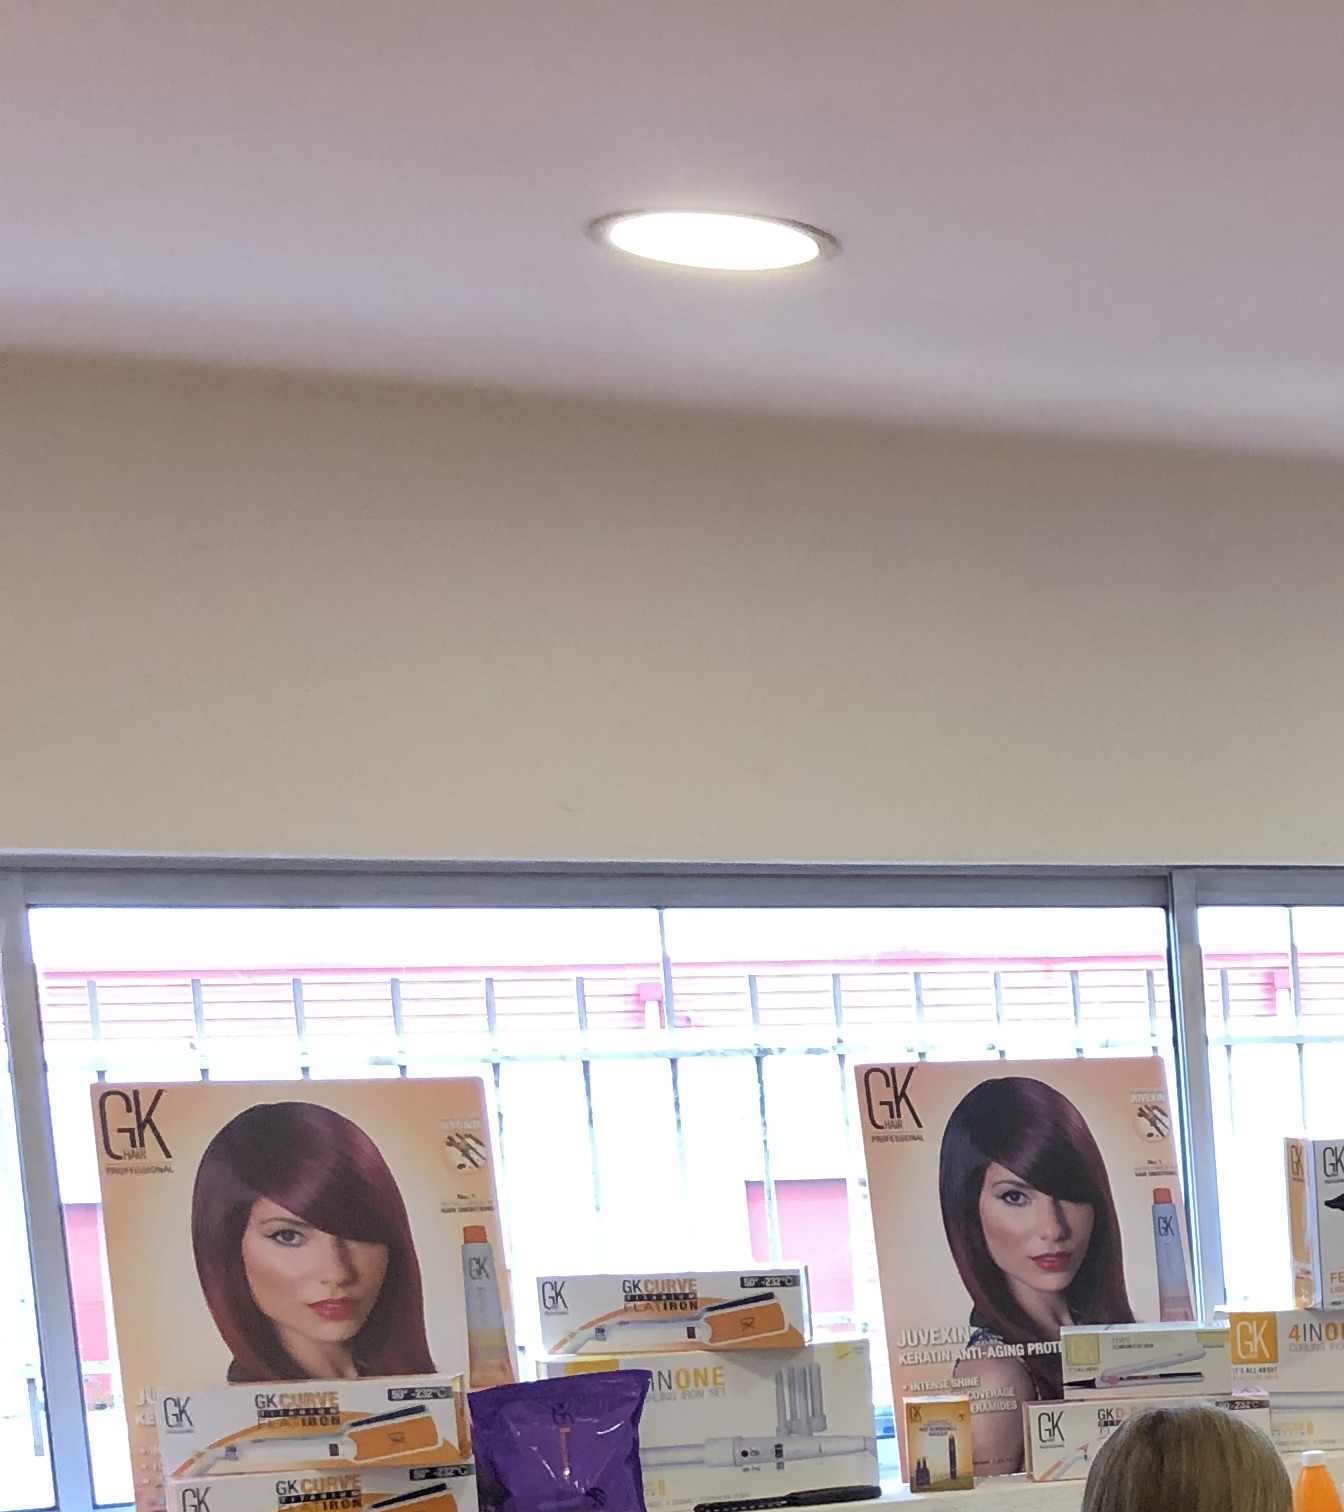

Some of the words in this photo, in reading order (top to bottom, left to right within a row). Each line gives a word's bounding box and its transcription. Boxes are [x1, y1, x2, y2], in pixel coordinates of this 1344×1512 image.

[864, 1066, 923, 1129] GK
[99, 1089, 172, 1160] GK
[872, 1134, 924, 1143] PROFESSIONAL
[1157, 1216, 1175, 1236] GK
[469, 1257, 490, 1279] GK
[542, 1281, 568, 1310] GK
[898, 1327, 970, 1348] JUVEXIN
[1237, 1320, 1270, 1359] GK
[899, 1350, 951, 1366] KERATIN
[954, 1345, 1025, 1361] ANTI-AGING
[911, 1379, 950, 1391] INTENSE
[952, 1377, 980, 1388] SHINE
[968, 1387, 1015, 1400] COVERAGE
[163, 1397, 194, 1428] GK
[1038, 1411, 1064, 1443] GK
